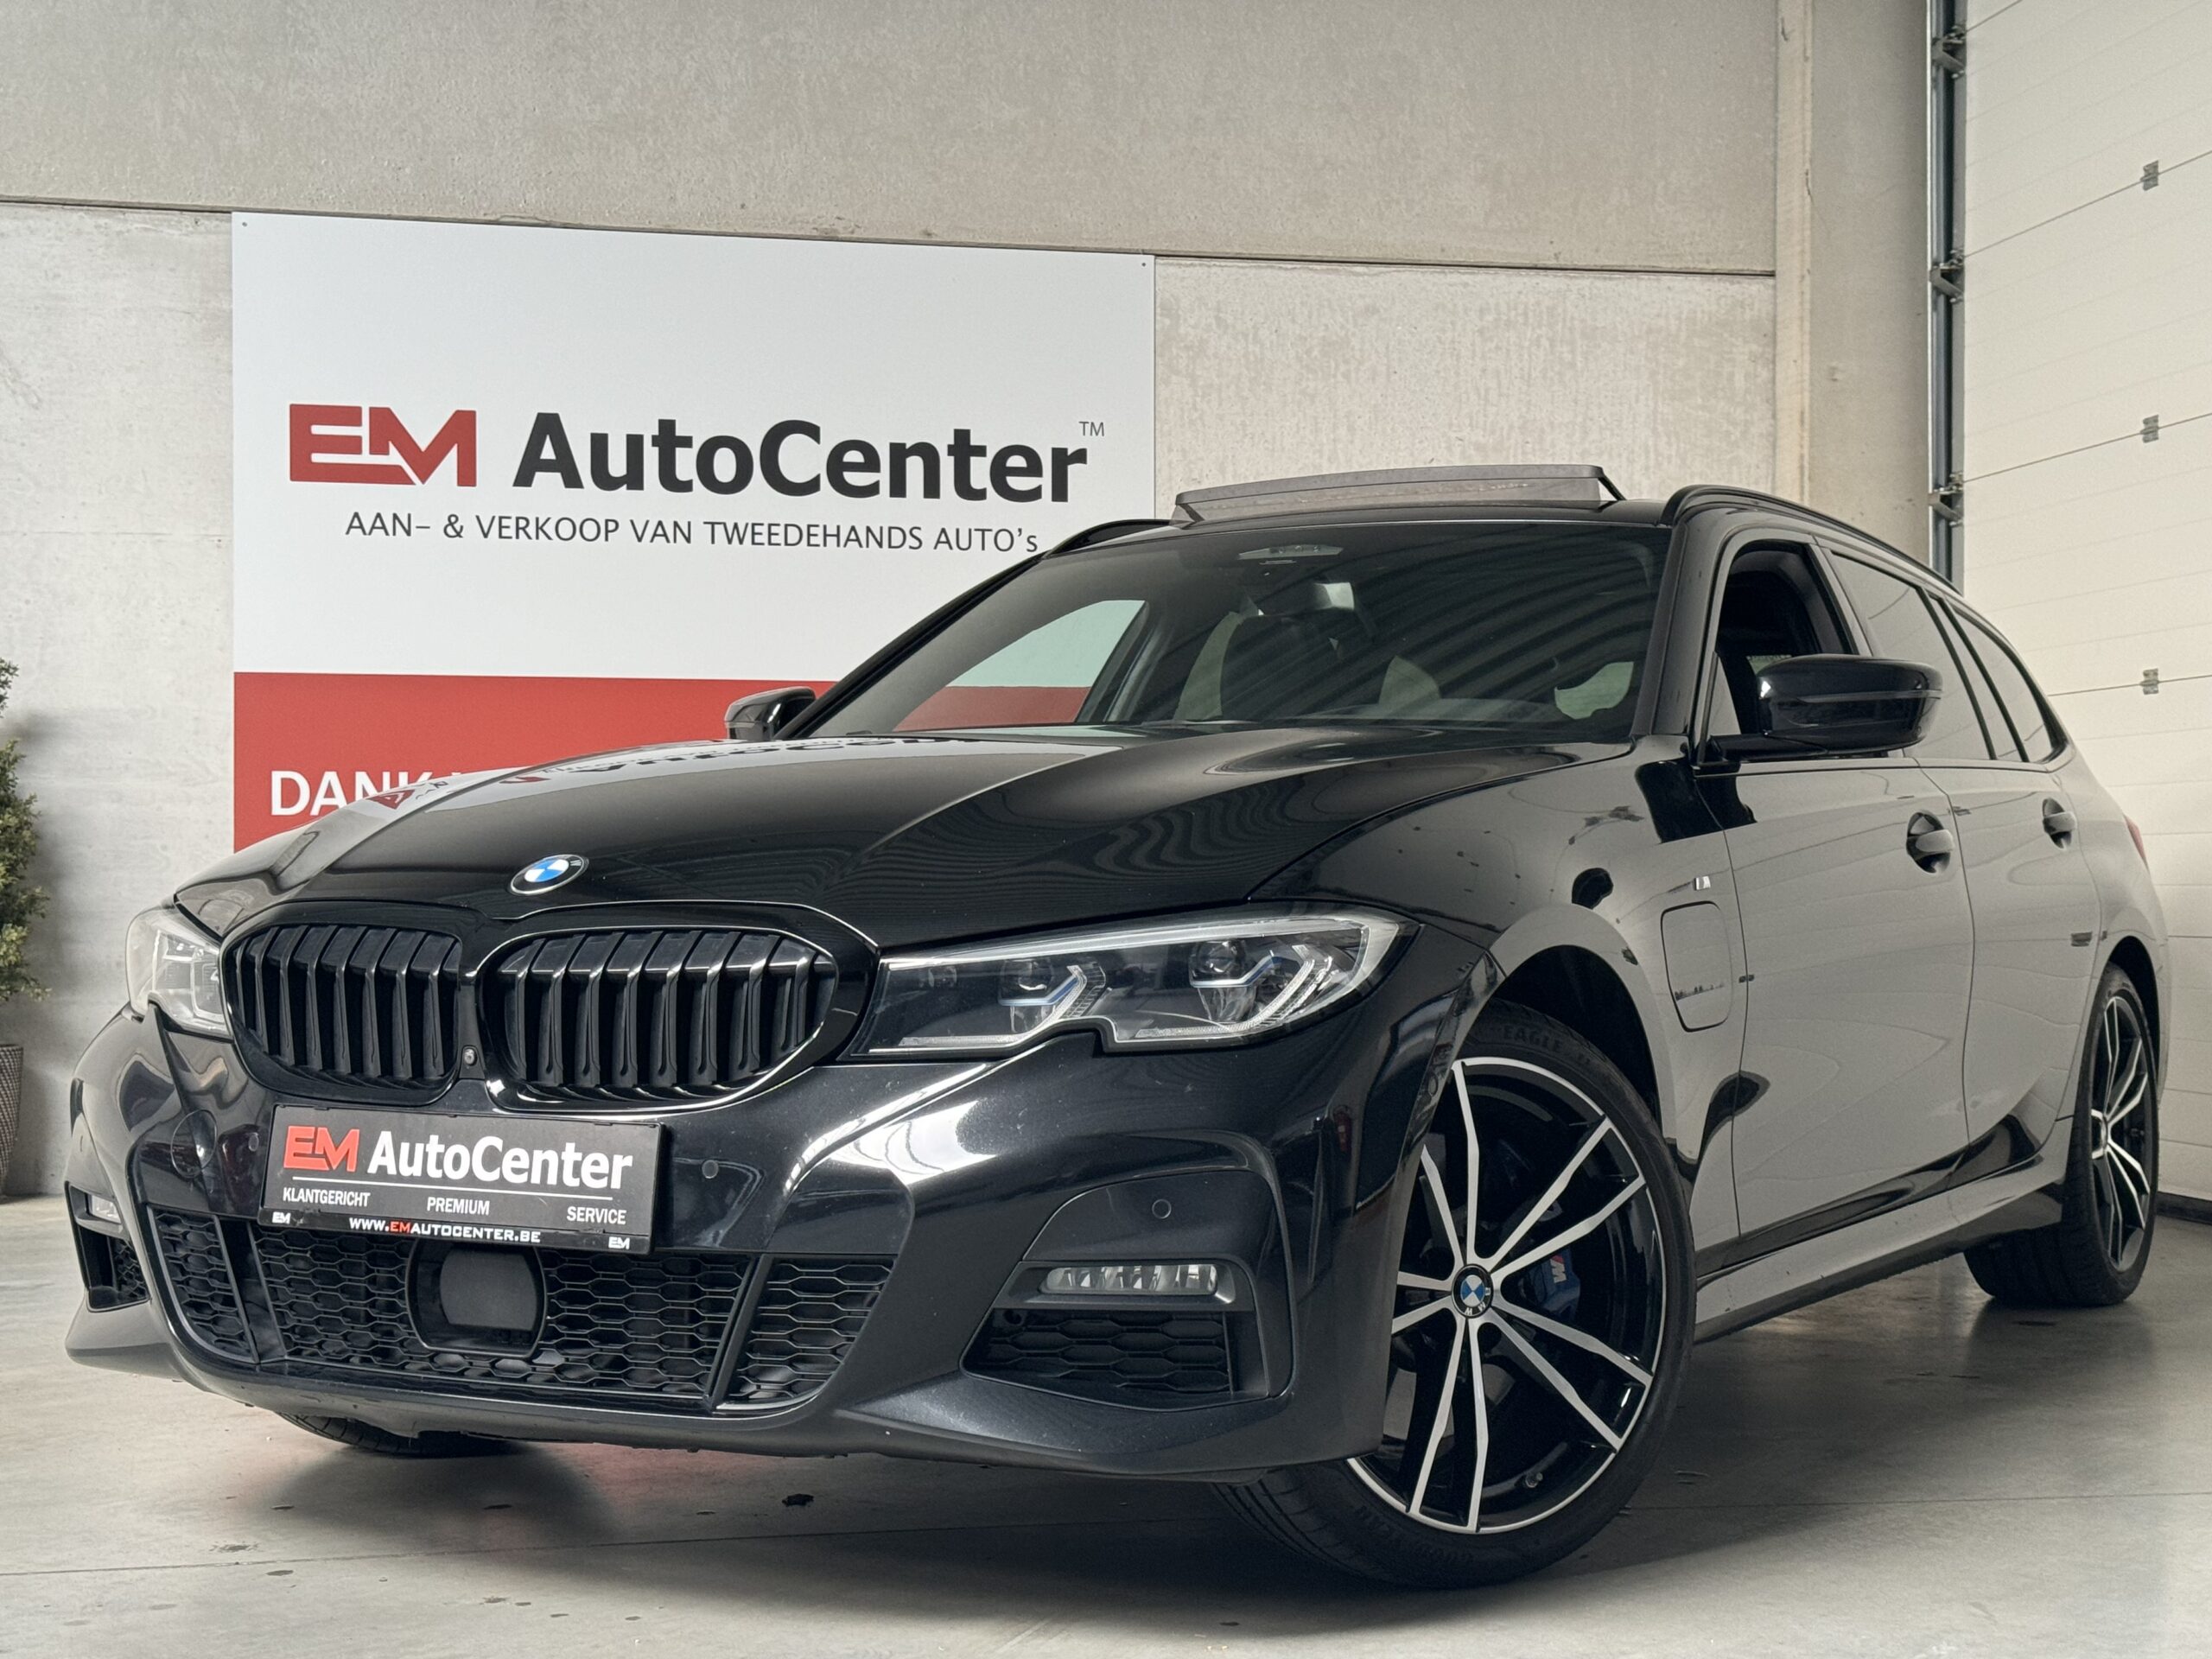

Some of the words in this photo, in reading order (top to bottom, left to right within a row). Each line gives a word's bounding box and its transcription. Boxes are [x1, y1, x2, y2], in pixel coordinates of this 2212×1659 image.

[289, 404, 476, 486] EM
[512, 412, 1087, 503] AutoCenter
[443, 514, 464, 538] &
[475, 515, 620, 542] VERKOOP
[630, 519, 692, 544] VAN
[703, 521, 923, 550] TWEEDEHANDS
[283, 1125, 359, 1172] EM
[367, 1130, 632, 1189] AutoCenter
[283, 1187, 370, 1207] KLANTGERICHT
[427, 1197, 490, 1216] PREMIUM
[567, 1206, 626, 1224] SERVICE
[349, 1217, 541, 1243] WWW.EMAUTOCENTER.BE
